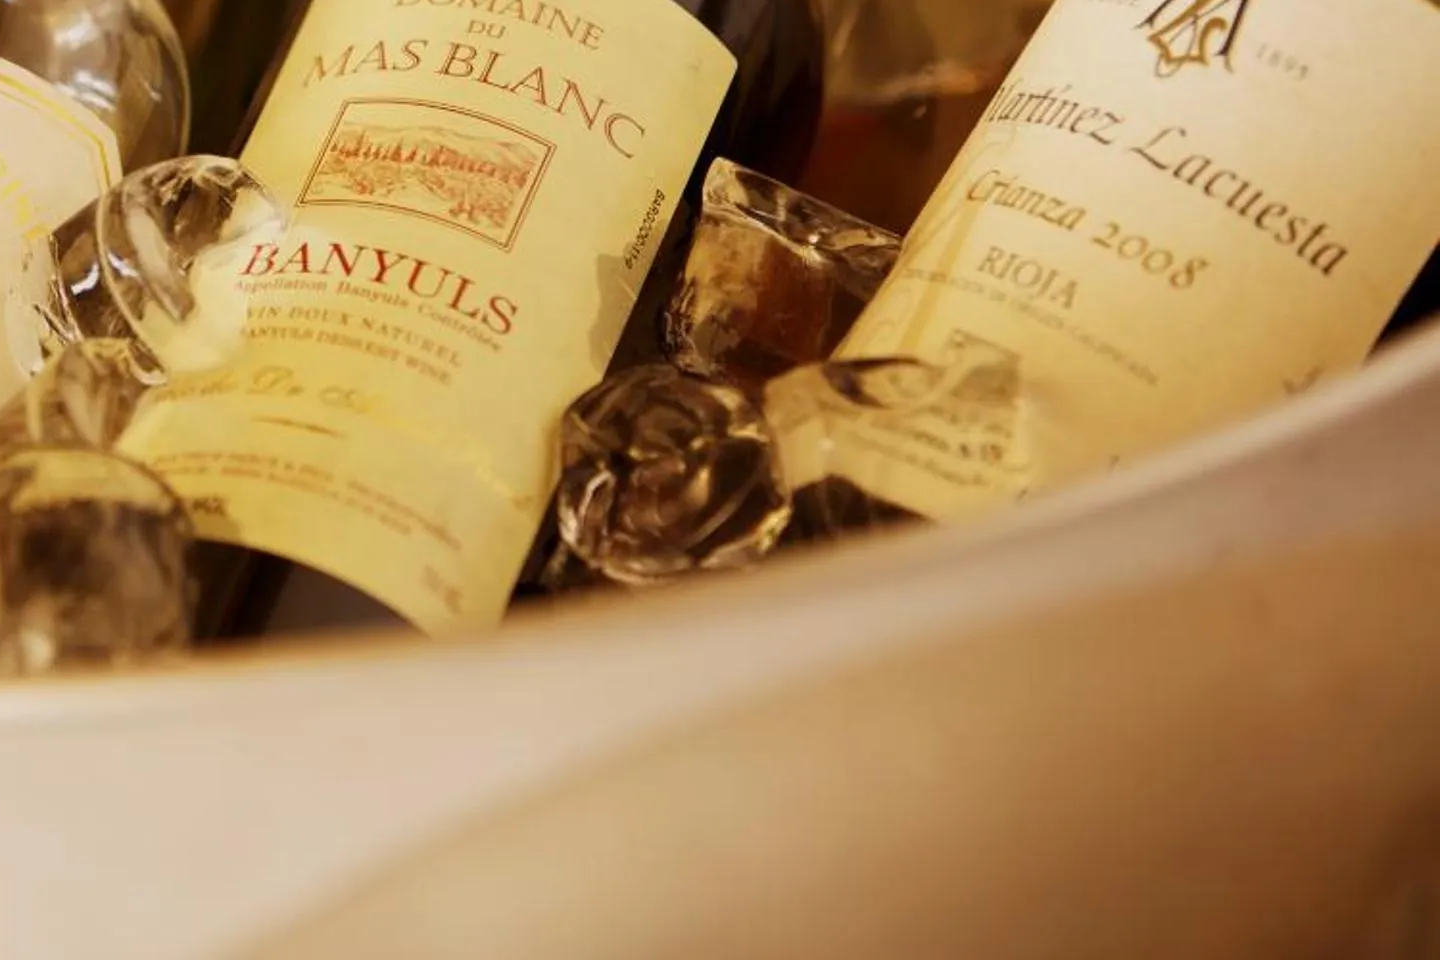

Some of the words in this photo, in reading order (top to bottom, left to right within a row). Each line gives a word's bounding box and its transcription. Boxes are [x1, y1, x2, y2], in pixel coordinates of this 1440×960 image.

[466, 18, 508, 41] DU
[301, 38, 429, 90] MAS
[434, 40, 647, 160] BLANC
[964, 167, 1088, 234] Crianza
[1090, 219, 1212, 292] 2008
[1127, 126, 1350, 279] Lacuesta
[235, 277, 328, 295] Appellation
[336, 280, 411, 309] Banyuls
[239, 240, 519, 337] BANYULS
[975, 244, 1081, 312] RIOJA
[246, 306, 282, 322] VIN
[288, 308, 351, 327] DOUX
[361, 316, 463, 368] NATUREL
